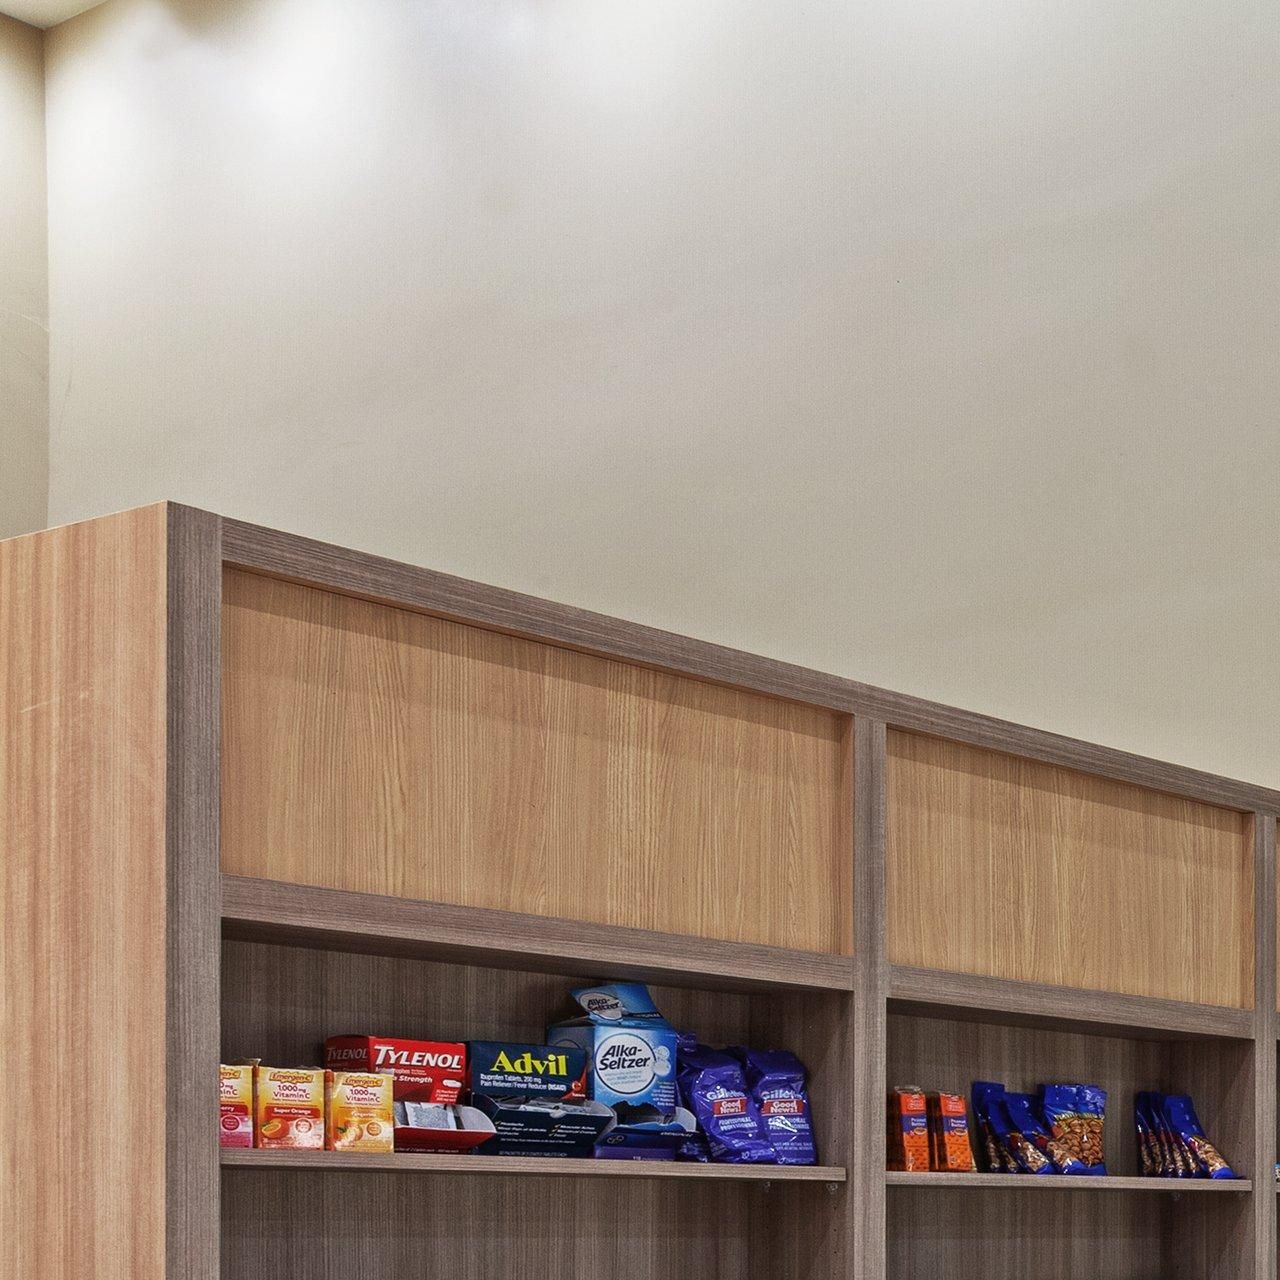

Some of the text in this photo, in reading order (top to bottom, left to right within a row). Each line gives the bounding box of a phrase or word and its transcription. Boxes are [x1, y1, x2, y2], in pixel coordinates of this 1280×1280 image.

[327, 1047, 368, 1061] TYLENOL
[602, 1045, 643, 1058] Alka-
[374, 1045, 462, 1069] TYLENOL
[489, 1051, 568, 1077] Advil
[599, 1056, 651, 1071] Seltzer
[399, 1075, 433, 1084] Strength
[480, 1073, 504, 1081] Ibuprofen
[273, 1090, 311, 1100] Vitamin C
[345, 1095, 375, 1103] Vitamin
[721, 1100, 741, 1108] Good
[772, 1100, 798, 1108] Good
